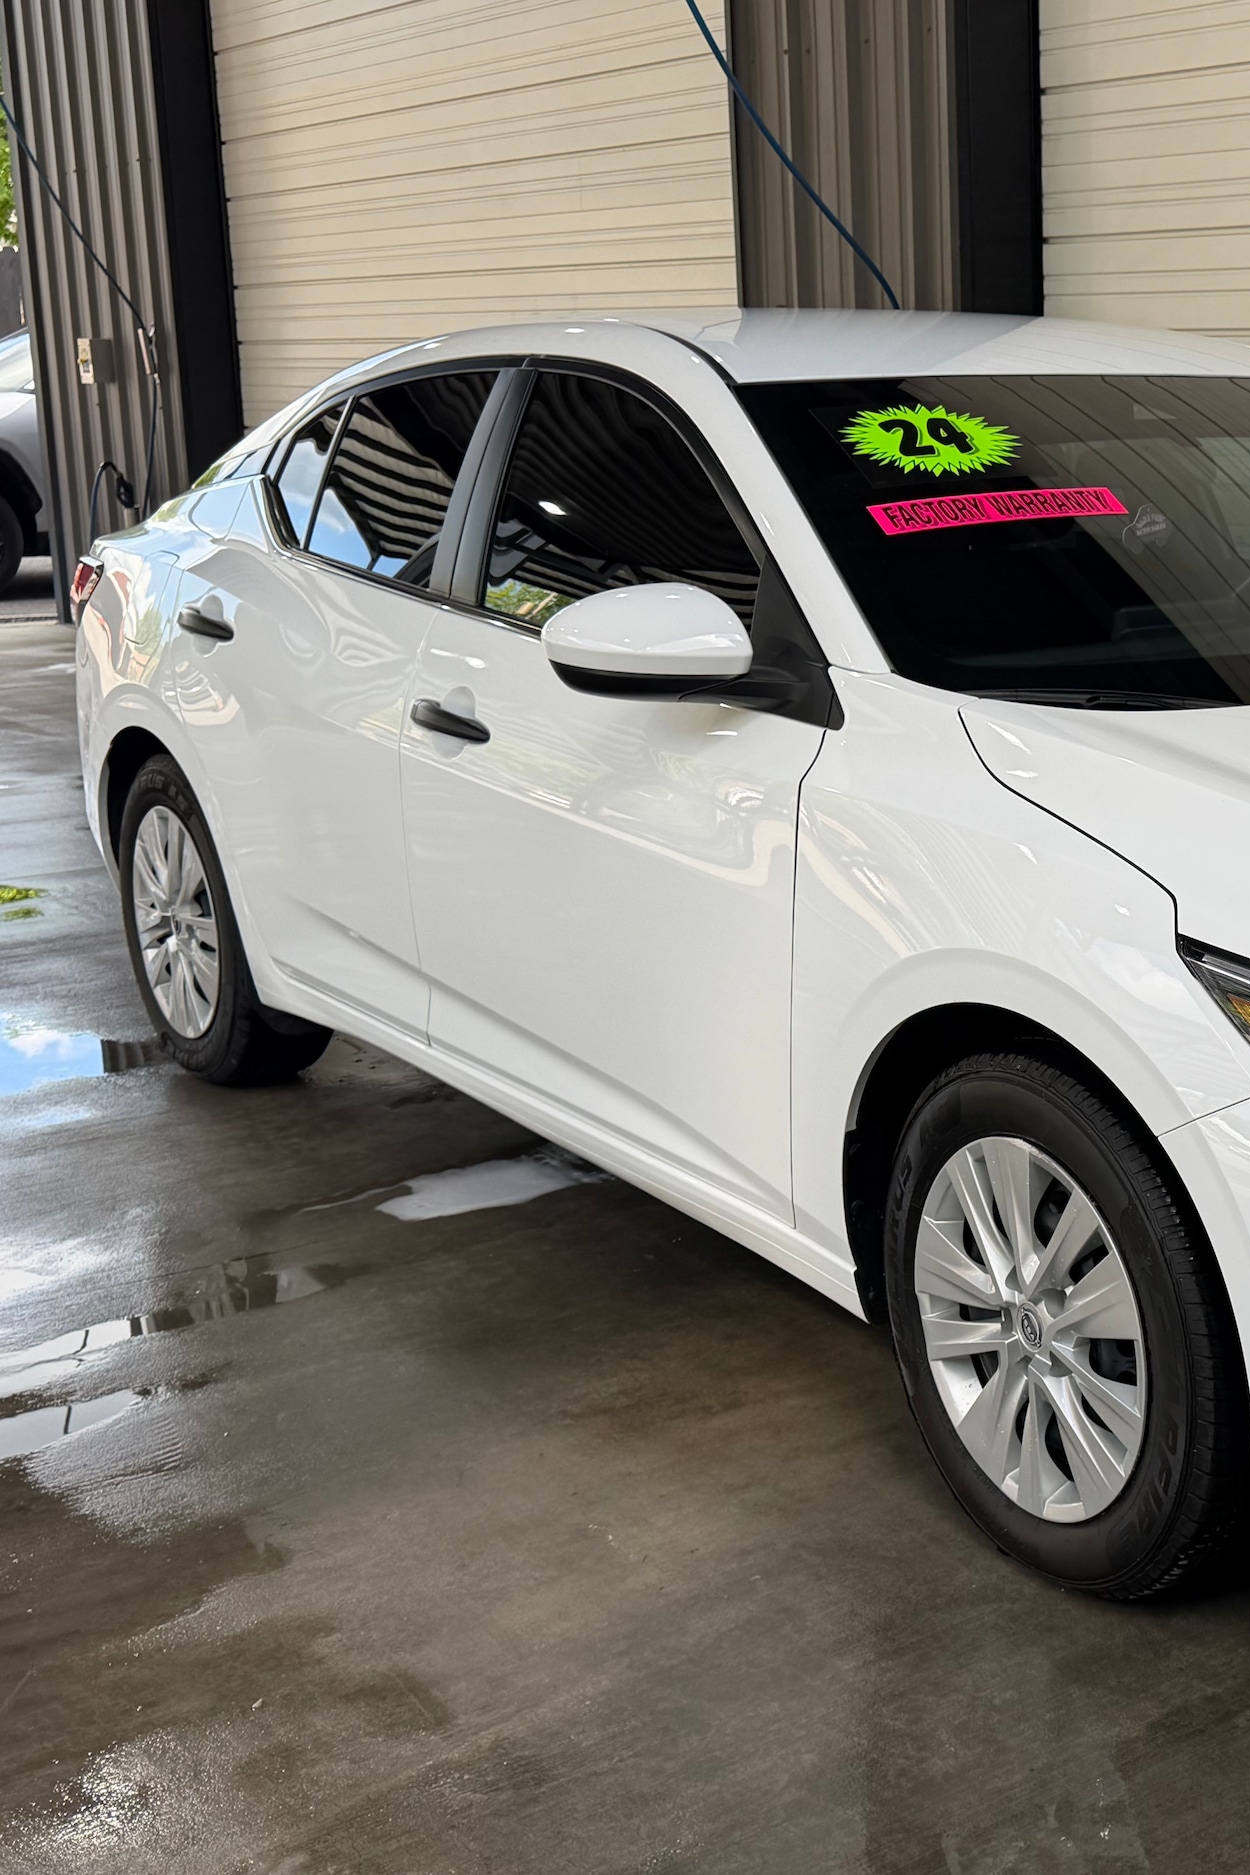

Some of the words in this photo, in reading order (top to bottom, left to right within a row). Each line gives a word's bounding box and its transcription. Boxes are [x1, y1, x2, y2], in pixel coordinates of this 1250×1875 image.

[878, 418, 977, 457] 24
[882, 496, 986, 529] FACTORY
[989, 490, 1112, 517] WARRANTY
